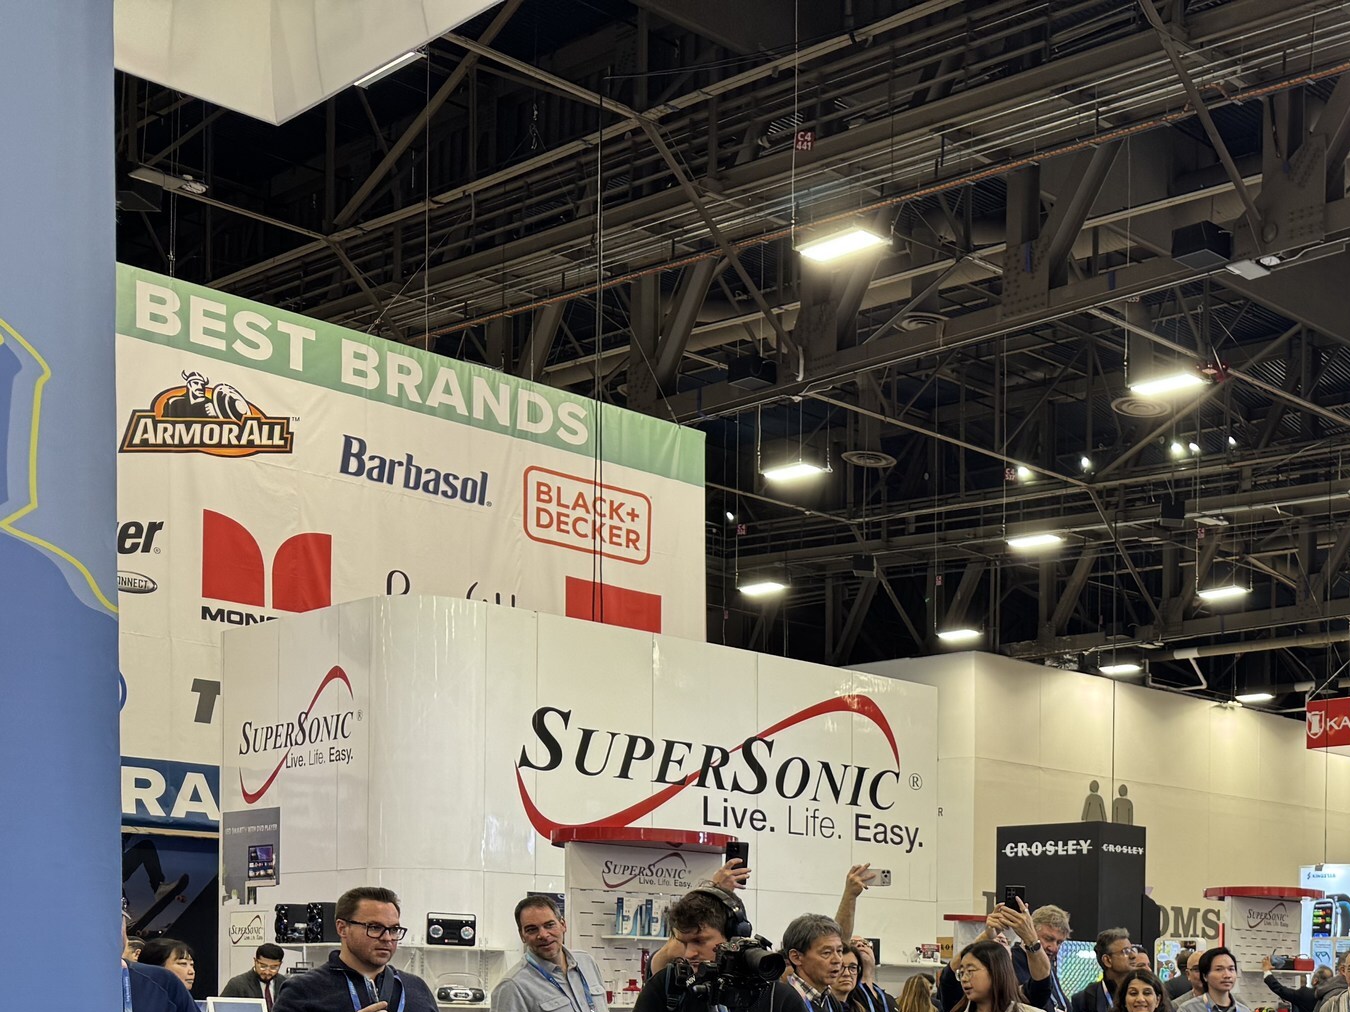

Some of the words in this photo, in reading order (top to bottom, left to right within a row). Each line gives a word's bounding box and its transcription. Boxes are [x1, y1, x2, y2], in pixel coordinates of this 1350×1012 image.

[136, 280, 316, 371] BEST
[341, 338, 589, 445] BRANDS
[339, 434, 489, 506] Barbasol
[536, 481, 640, 523] BLACK+
[536, 507, 641, 551] DECKER
[202, 606, 279, 626] MON
[286, 752, 306, 769] Live.
[308, 748, 326, 766] Life.
[329, 746, 354, 765] Easy.
[702, 796, 775, 833] Live.
[788, 805, 842, 840] Life.
[855, 813, 924, 853] Easy.
[1004, 839, 1092, 857] CROSLEY
[1102, 843, 1144, 855] CROSLEY
[673, 879, 693, 889] Easy.
